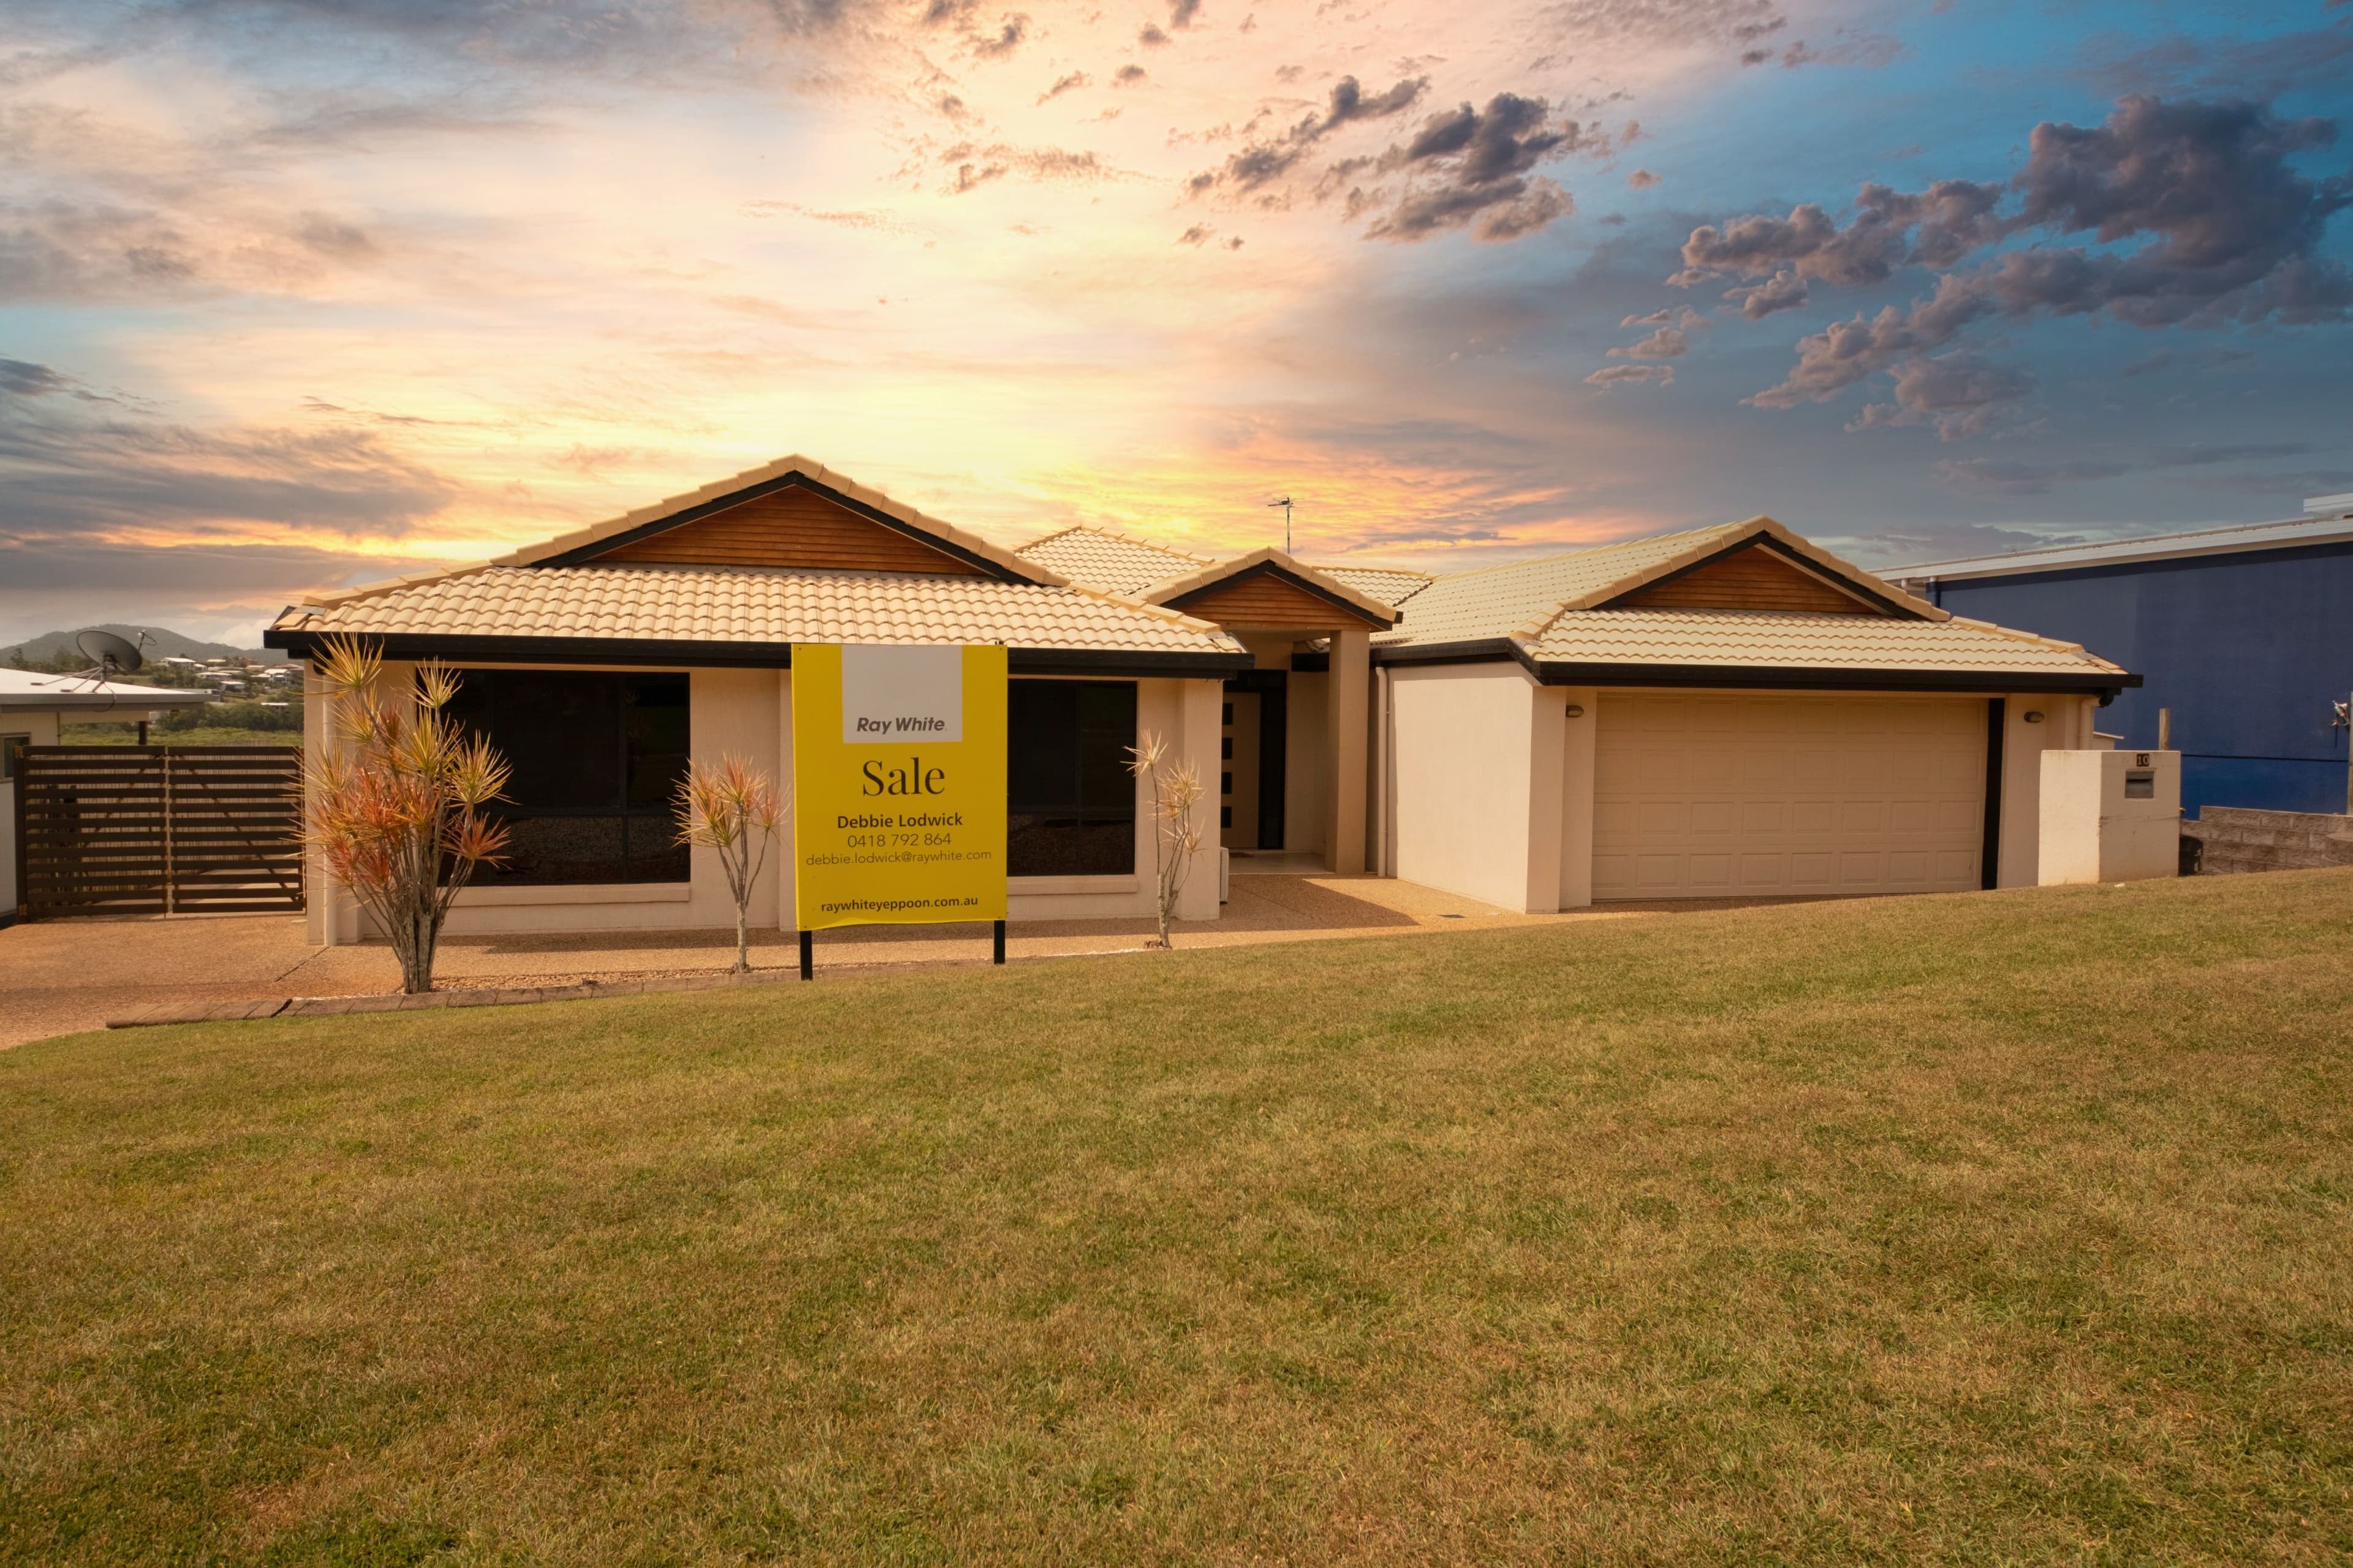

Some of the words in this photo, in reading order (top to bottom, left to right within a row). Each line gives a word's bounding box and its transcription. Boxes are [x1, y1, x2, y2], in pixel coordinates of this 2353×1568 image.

[857, 717, 892, 735] Ray
[895, 717, 945, 732] White
[2137, 755, 2149, 765] 10
[863, 757, 945, 797] Sale
[837, 814, 894, 829] Debbie
[898, 812, 963, 827] Lodwick
[847, 835, 886, 848] 0418
[891, 833, 919, 846] 792
[923, 833, 952, 846] 864
[806, 850, 991, 866] debbie.lodwick@raywhite.com
[820, 896, 979, 913] raywhiteyeppoon.com.au
